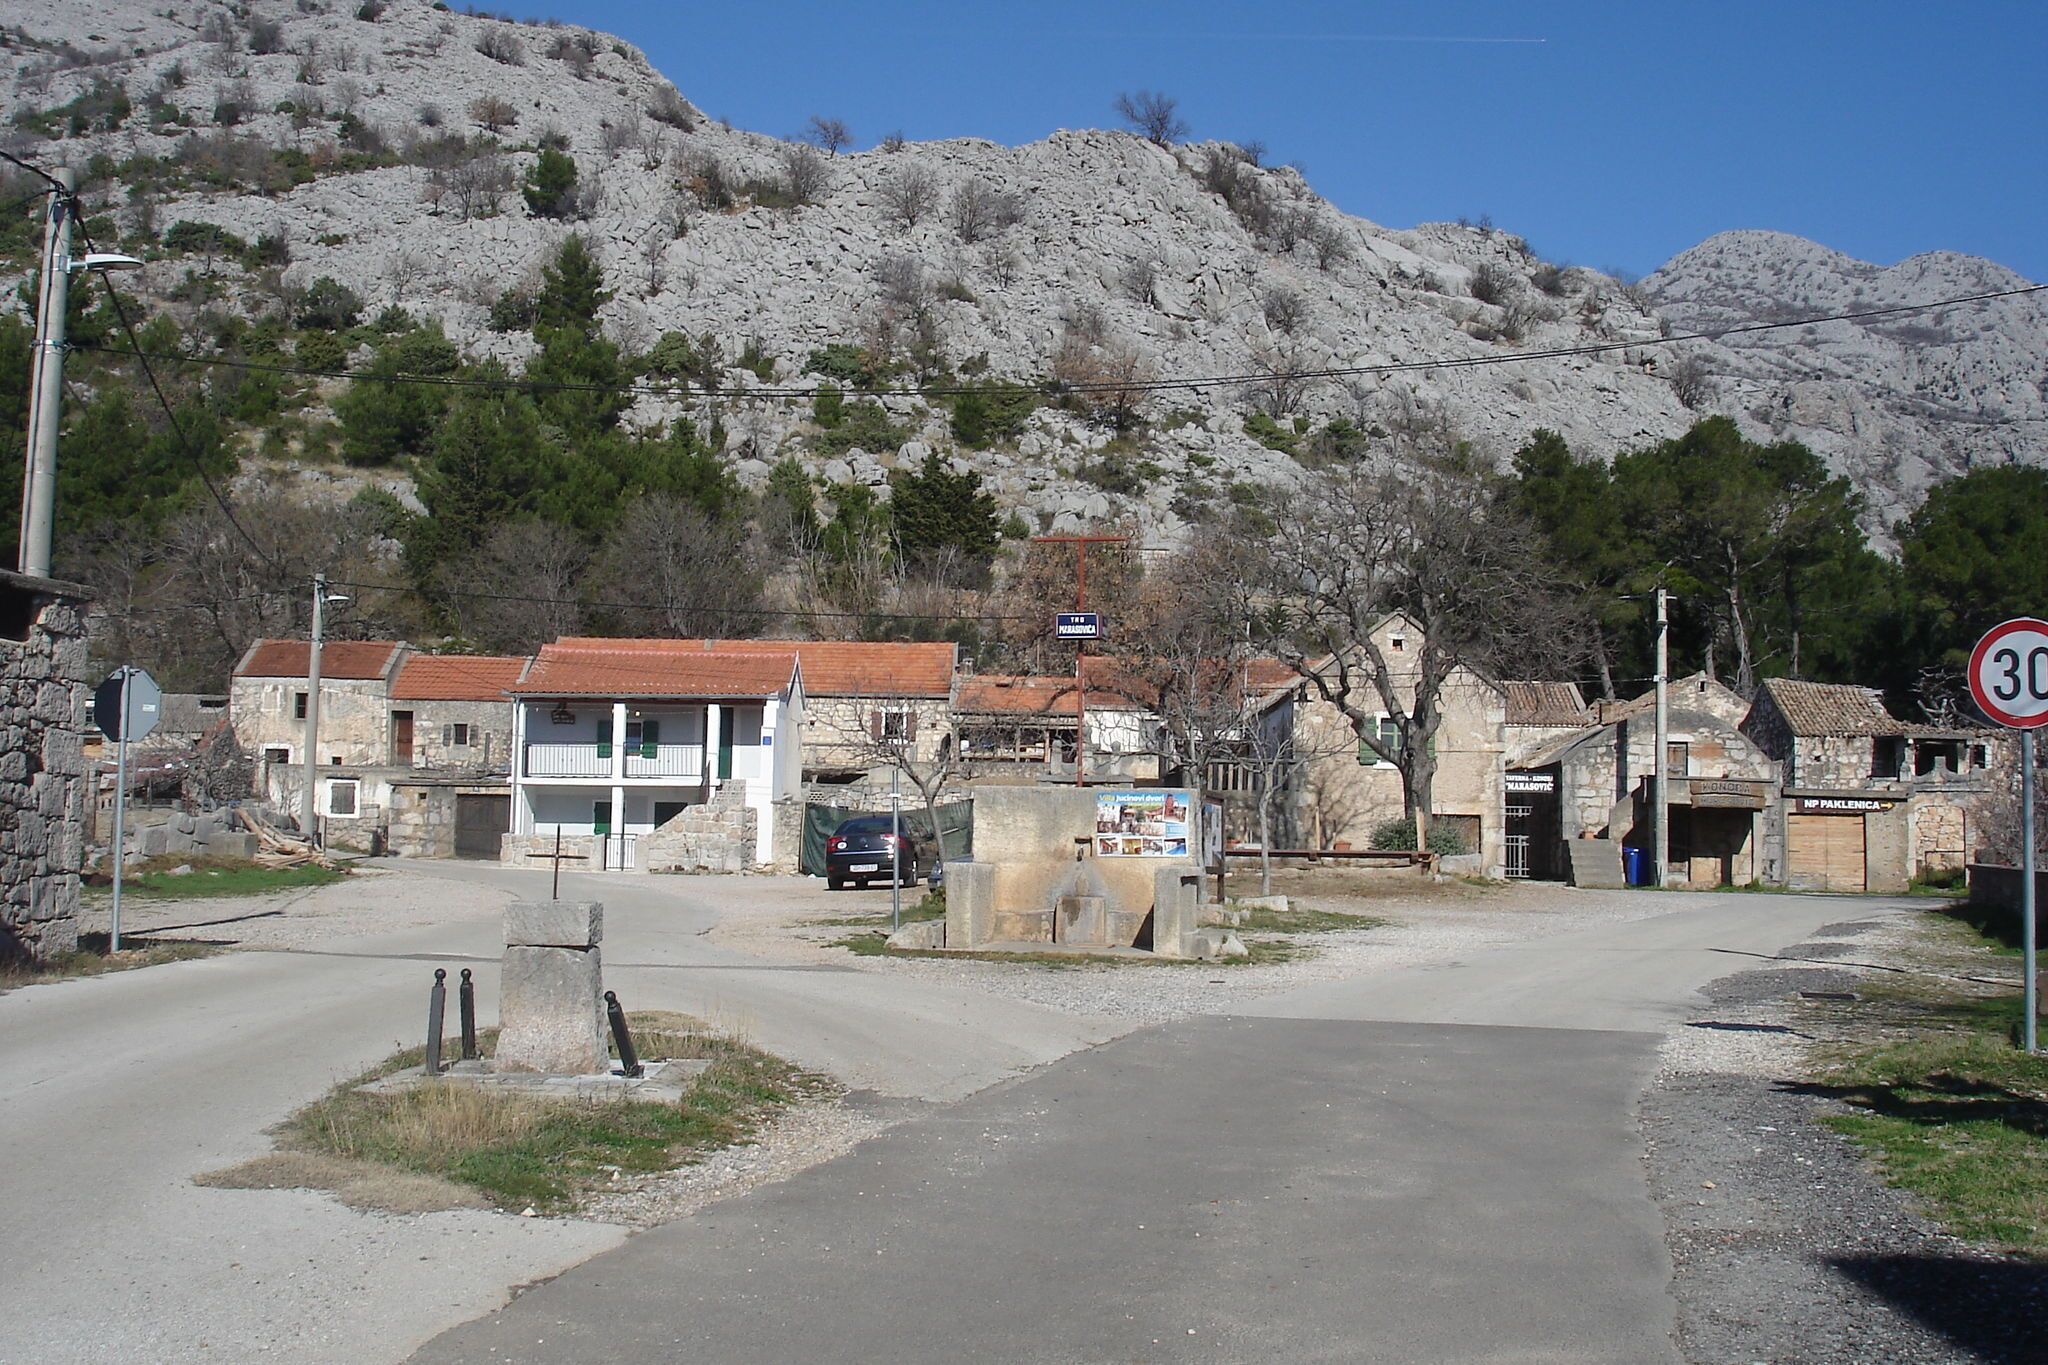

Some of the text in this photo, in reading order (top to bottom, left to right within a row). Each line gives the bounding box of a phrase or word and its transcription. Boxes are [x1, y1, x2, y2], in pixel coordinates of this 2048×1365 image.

[1993, 647, 2048, 700] 30
[1702, 782, 1751, 793] KONOBA
[1099, 794, 1115, 802] Villa
[1145, 794, 1164, 802] dvori
[1804, 799, 1881, 809] NP PAKLENICA
